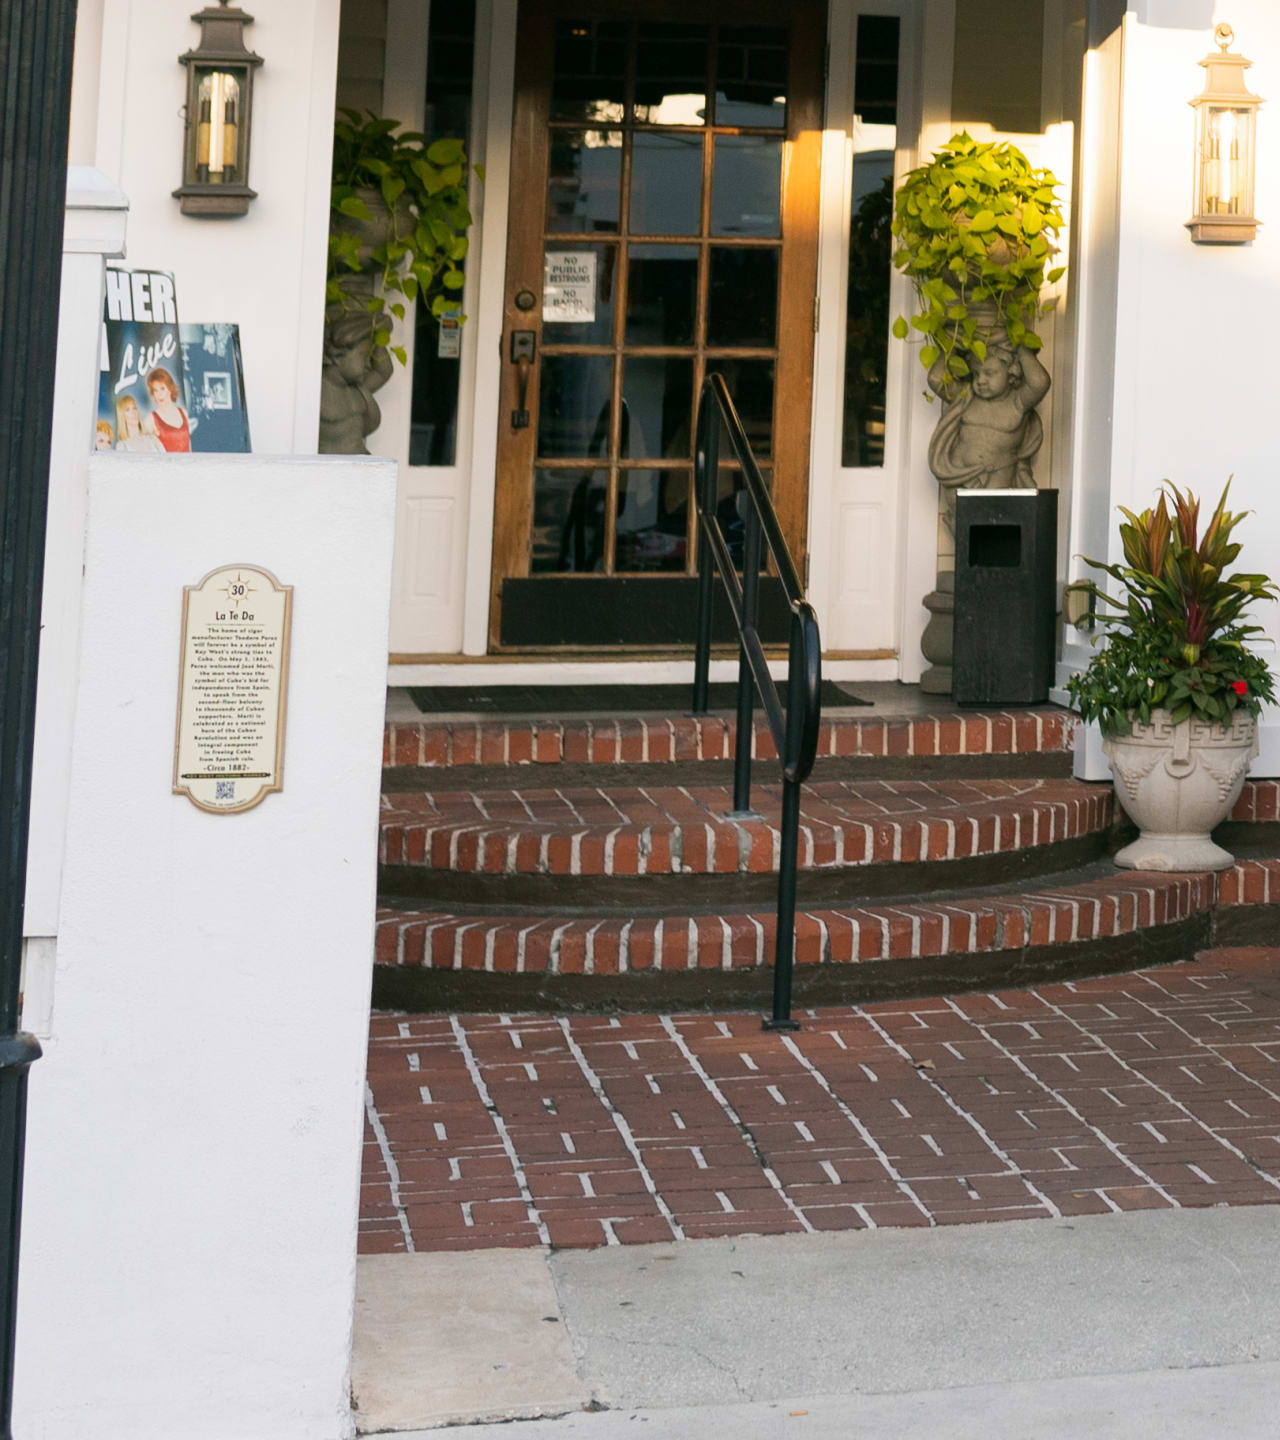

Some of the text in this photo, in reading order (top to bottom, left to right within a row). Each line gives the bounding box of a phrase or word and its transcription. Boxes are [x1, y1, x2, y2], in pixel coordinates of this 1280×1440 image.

[564, 256, 578, 265] NO
[552, 265, 588, 274] PUBLIC
[550, 274, 591, 283] RESTROOMS
[114, 333, 177, 395] Live
[231, 584, 245, 596] 30
[215, 610, 255, 621] La Te Da
